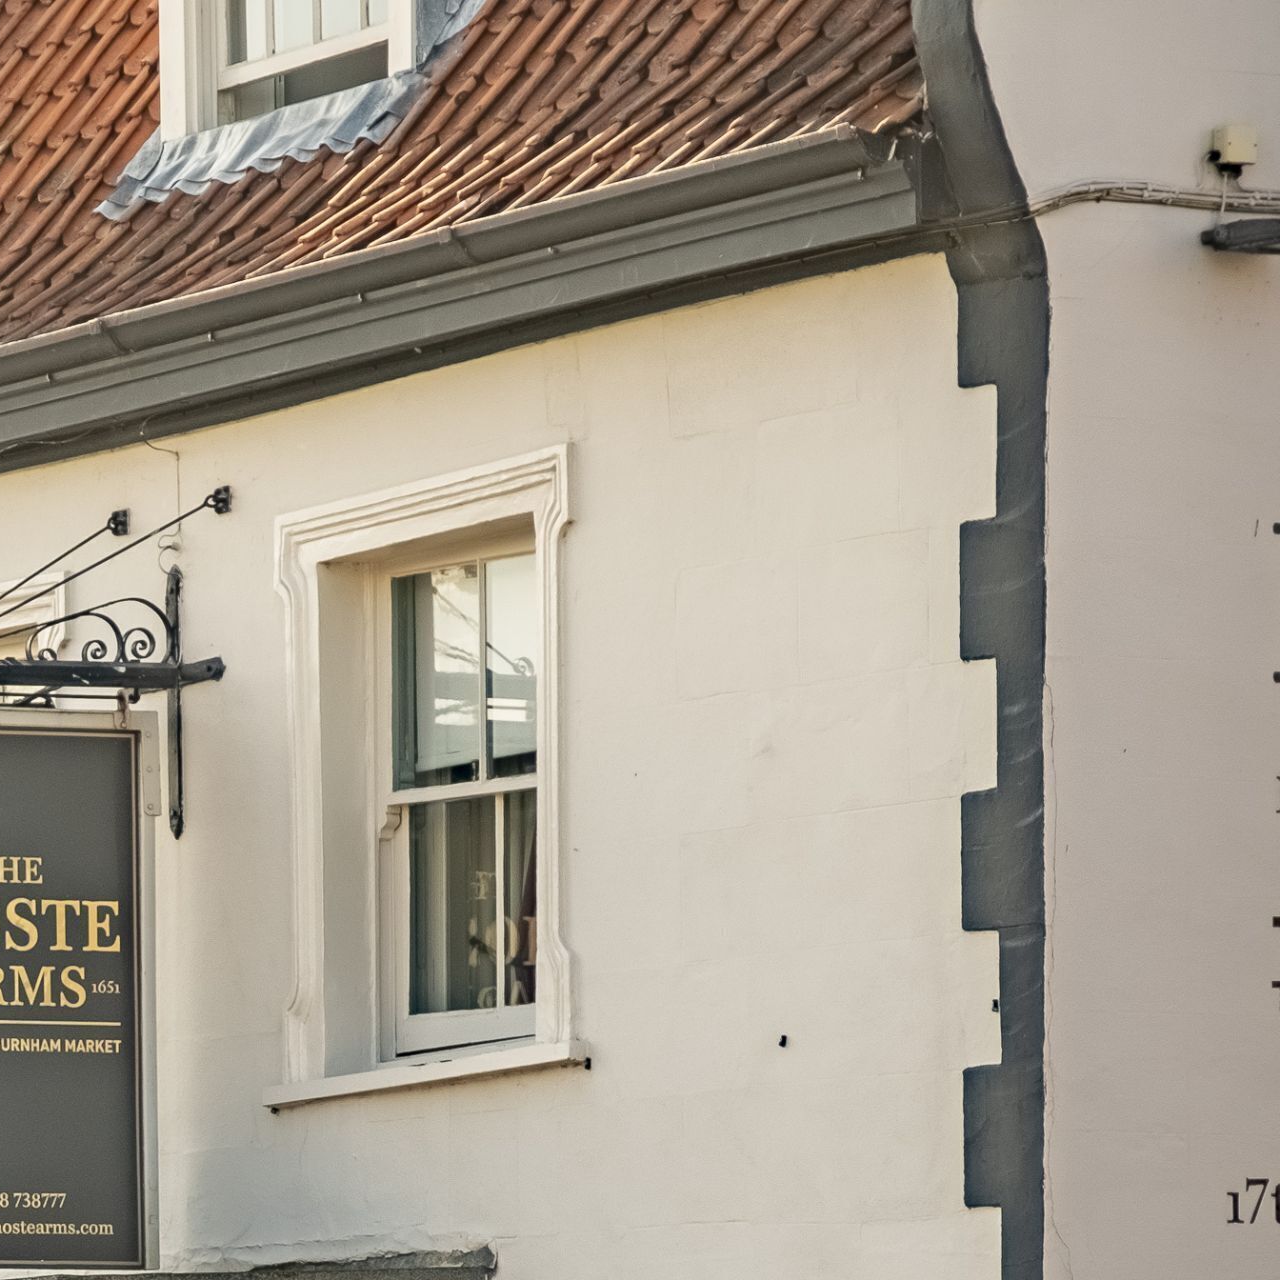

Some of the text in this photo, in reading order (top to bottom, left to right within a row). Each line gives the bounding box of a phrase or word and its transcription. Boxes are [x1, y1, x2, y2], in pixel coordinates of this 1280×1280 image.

[91, 980, 121, 994] 1651
[64, 1039, 122, 1054] MARKET
[13, 1192, 67, 1208] 738777
